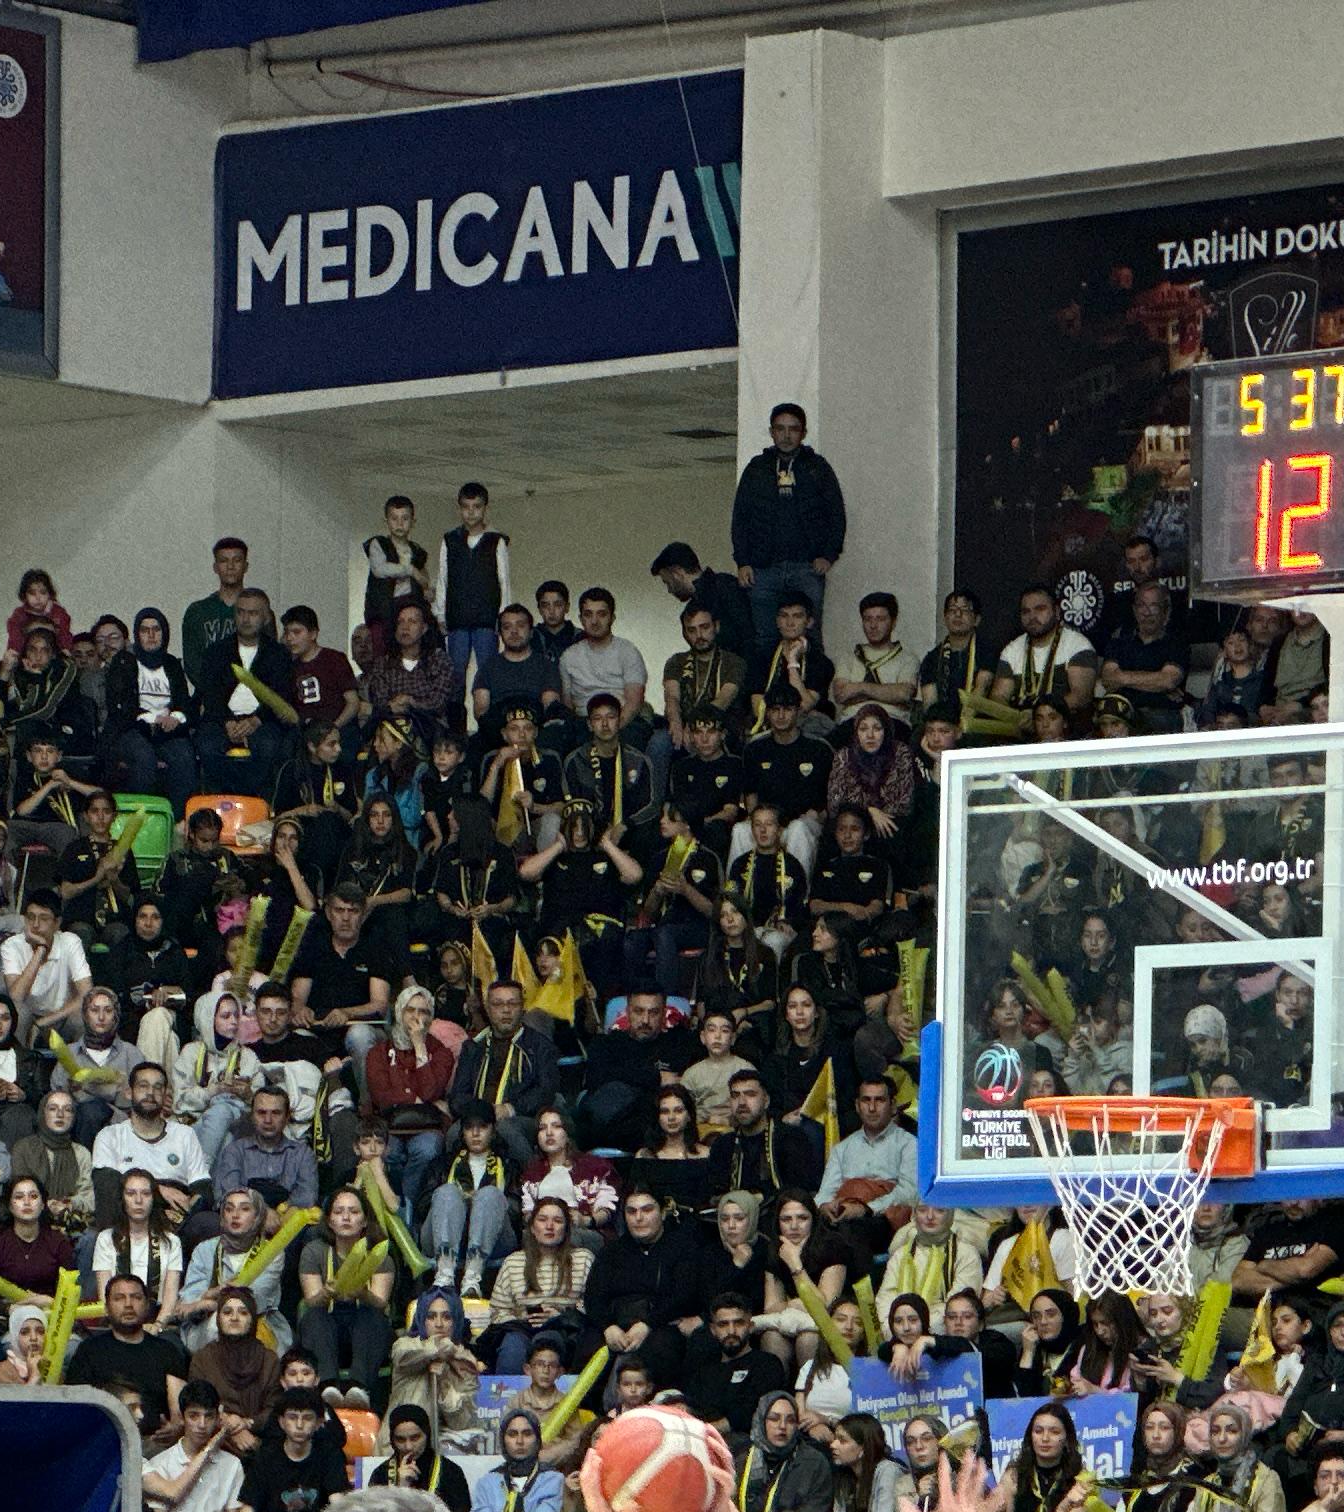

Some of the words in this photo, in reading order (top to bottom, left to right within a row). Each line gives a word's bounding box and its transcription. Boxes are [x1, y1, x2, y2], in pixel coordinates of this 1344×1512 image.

[237, 170, 699, 311] MEDICANA
[1159, 226, 1268, 271] TARİHİN
[1256, 453, 1335, 573] 12
[1146, 856, 1314, 889] www.tbf.org.tr
[962, 1134, 1030, 1148] BASKETBOL
[972, 1119, 1022, 1134] TÜRKİYE
[984, 1146, 1007, 1160] LİGİ
